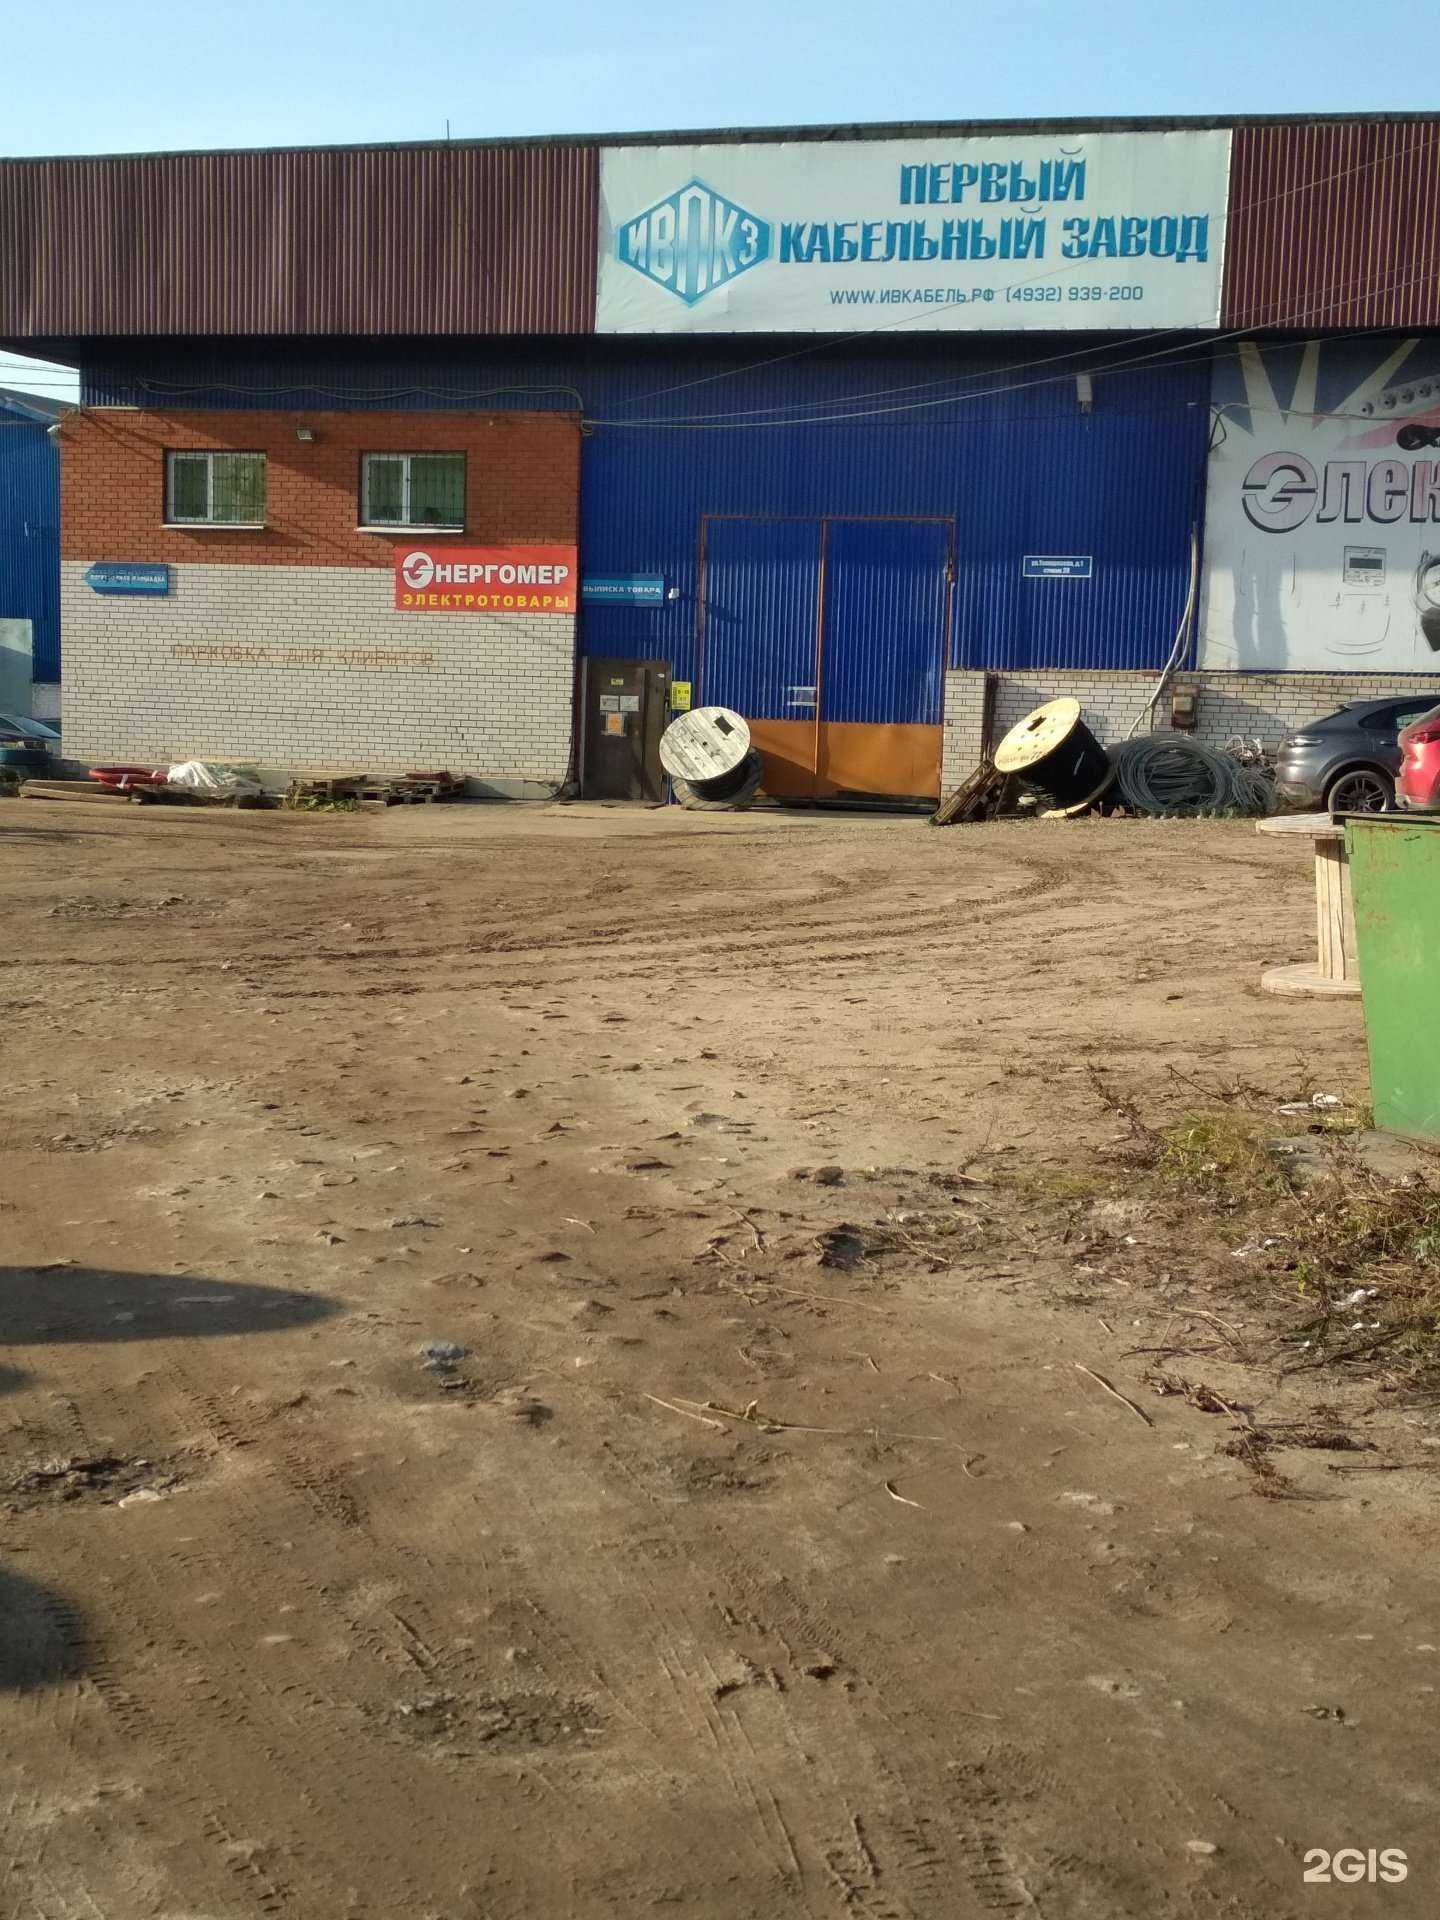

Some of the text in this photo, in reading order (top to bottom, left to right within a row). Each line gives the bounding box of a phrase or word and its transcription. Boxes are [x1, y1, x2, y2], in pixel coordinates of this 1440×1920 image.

[899, 146, 1087, 205] ПЕРВЫЙ
[779, 204, 1210, 264] КАБЕЛЬНЫЙ ЗАВОД
[1005, 284, 1062, 302] (4932)
[1067, 285, 1144, 302] 939-200
[583, 584, 662, 595] ВЫПИСКА ТОВАРА
[402, 594, 569, 609] ЭЛЕКТРОТОВАРЫ
